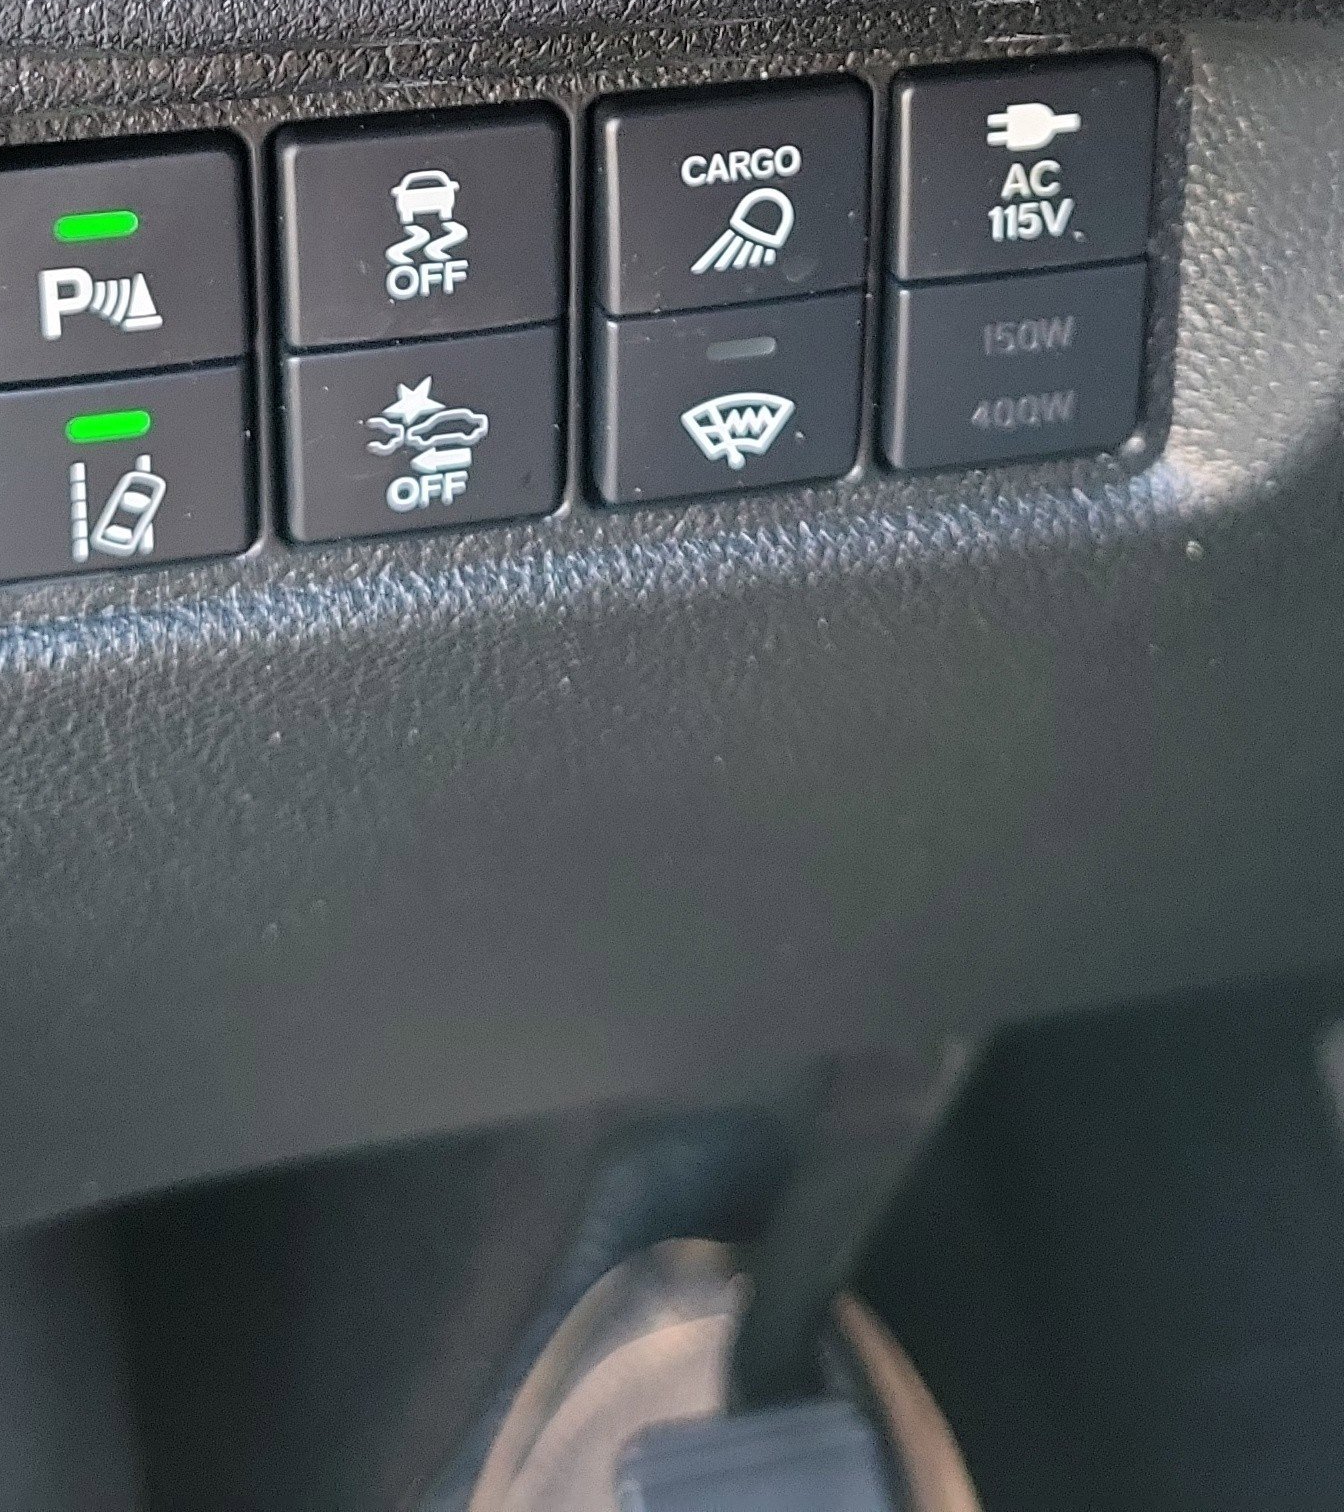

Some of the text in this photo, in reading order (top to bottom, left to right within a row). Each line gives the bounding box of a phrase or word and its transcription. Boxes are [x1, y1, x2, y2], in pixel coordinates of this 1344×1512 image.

[681, 145, 802, 188] CARGO
[1001, 160, 1061, 200] AC
[988, 198, 1075, 242] 115V
[386, 258, 468, 300] OFF
[38, 266, 93, 339] P
[982, 316, 1074, 356] 150W
[971, 390, 1076, 430] 400W
[386, 470, 468, 513] OFF
